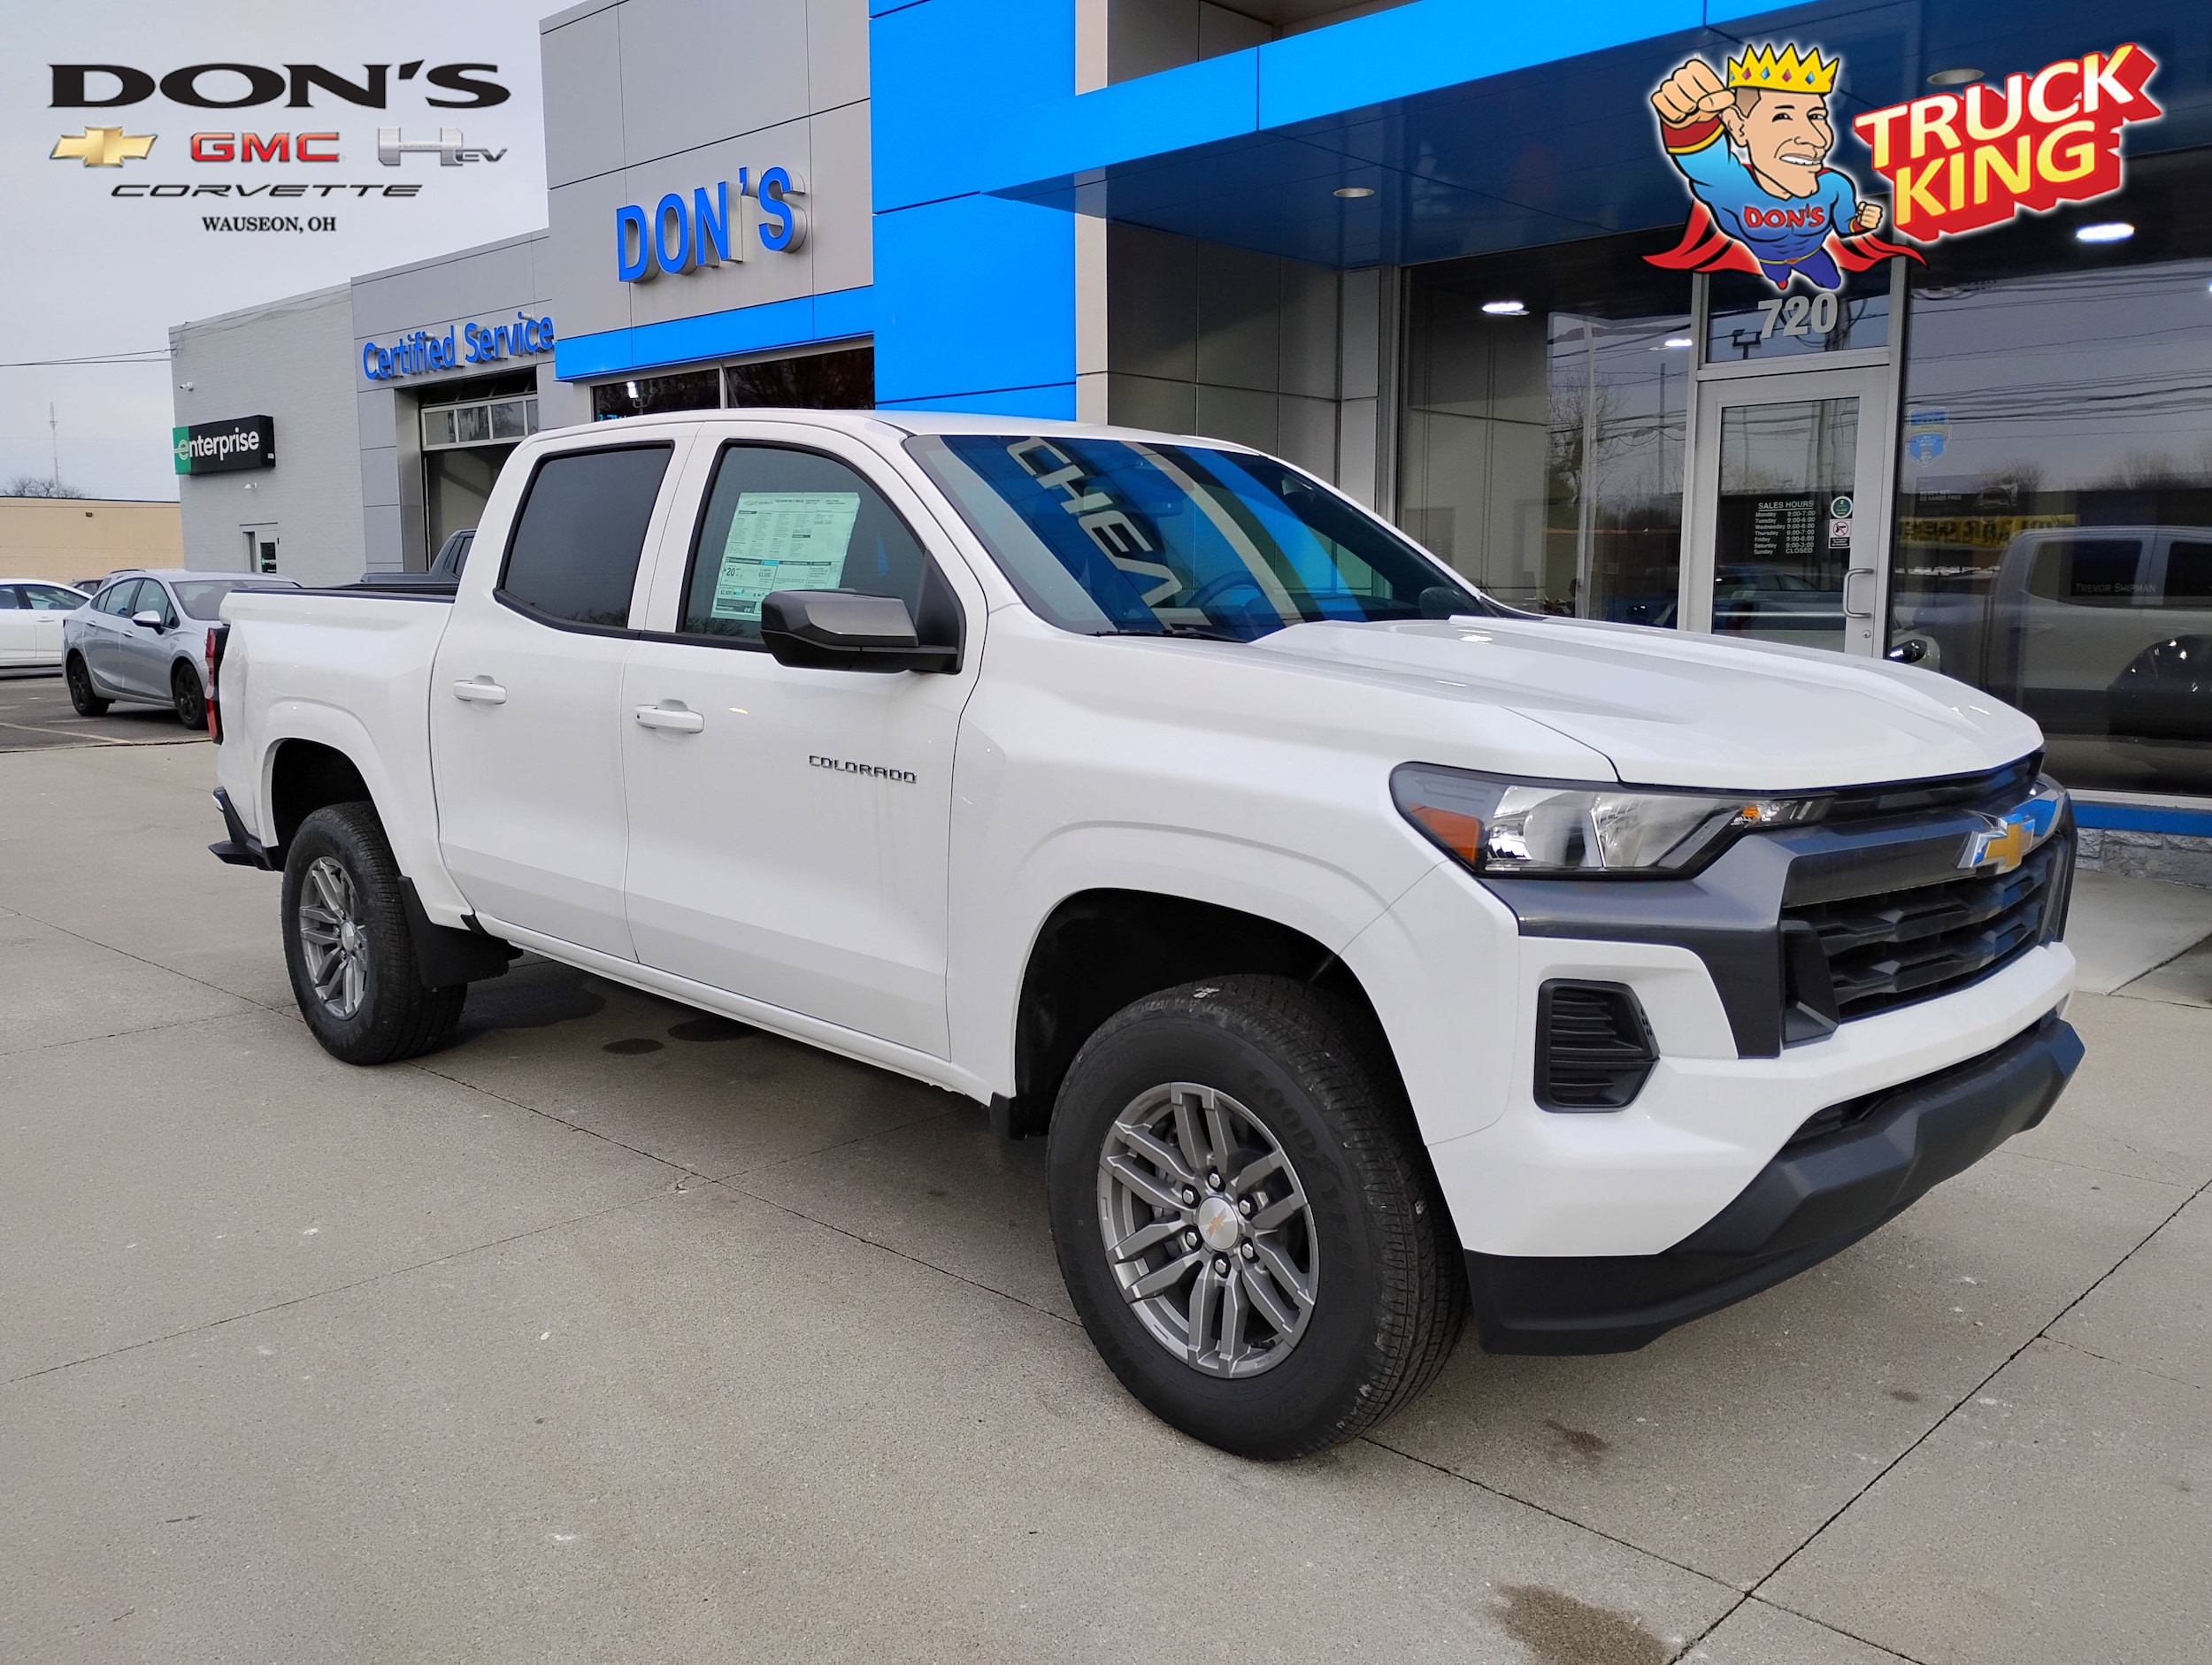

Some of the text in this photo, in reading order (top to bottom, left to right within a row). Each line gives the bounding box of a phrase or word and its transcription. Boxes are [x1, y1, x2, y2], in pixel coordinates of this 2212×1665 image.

[616, 166, 798, 282] DON'S
[1757, 292, 1839, 340] 720
[363, 311, 555, 380] Certified Service
[175, 426, 260, 461] enterprise
[1786, 500, 1814, 509] HOURS
[2075, 582, 2112, 593] TREVOR
[809, 755, 918, 784] COLORADO
